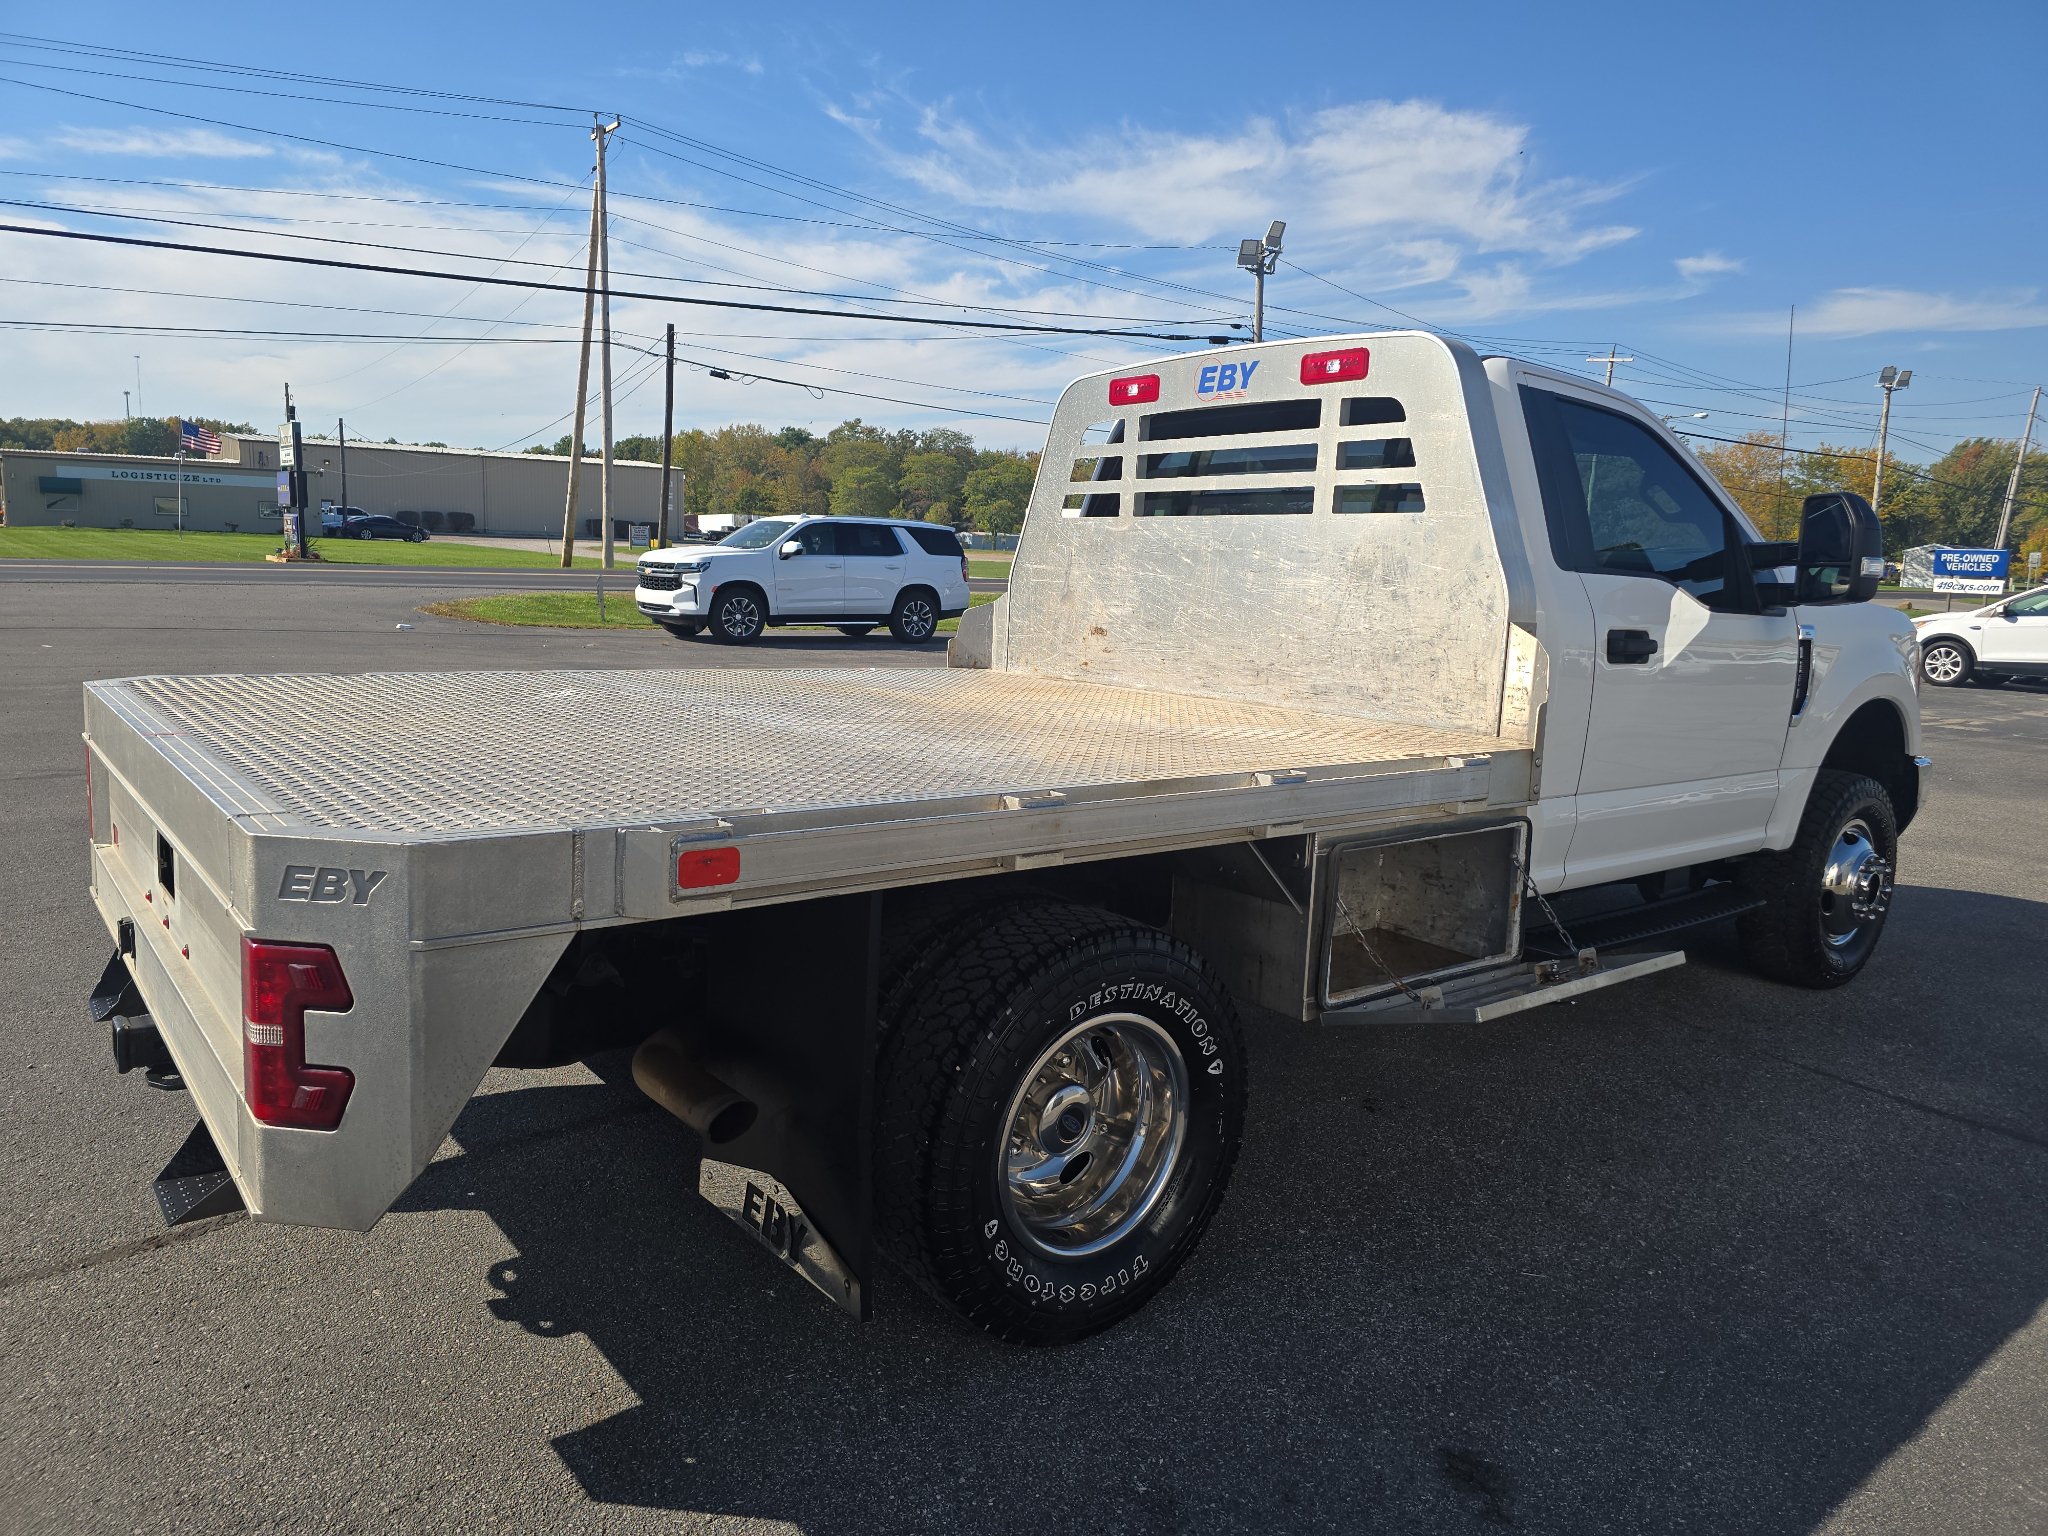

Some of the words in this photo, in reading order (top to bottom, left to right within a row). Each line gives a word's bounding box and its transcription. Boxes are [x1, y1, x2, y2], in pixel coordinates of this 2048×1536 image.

[1198, 360, 1260, 393] EBY
[1941, 554, 1999, 563] PRE-OWNED
[1946, 563, 1992, 571] VEHICLES
[1936, 582, 2000, 591] 419cars.com
[278, 865, 388, 906] EBY
[1069, 983, 1217, 1055] DESTINATION
[742, 1181, 808, 1264] EBY
